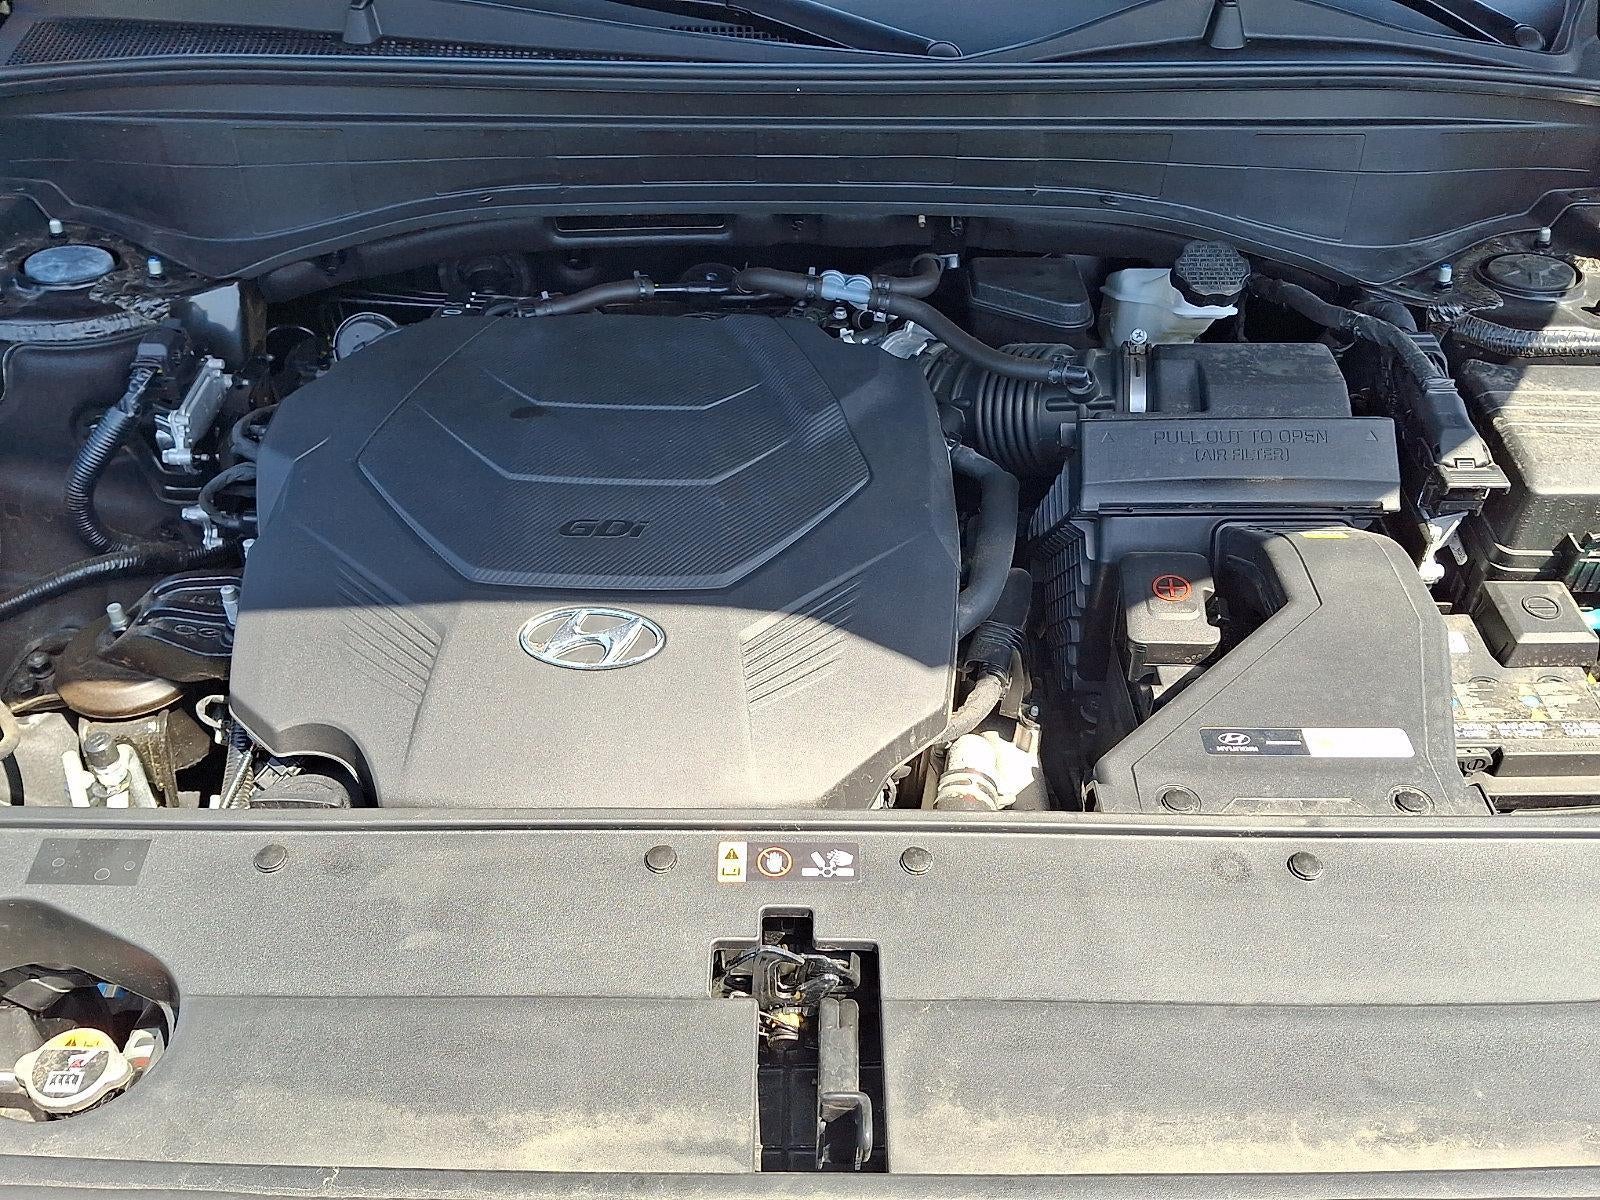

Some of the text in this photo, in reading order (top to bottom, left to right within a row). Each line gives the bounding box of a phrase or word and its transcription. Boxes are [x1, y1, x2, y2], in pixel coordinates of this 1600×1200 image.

[1154, 429, 1329, 445] PULL OUT TO OPEN
[1195, 447, 1290, 462] (AIR FILTER)
